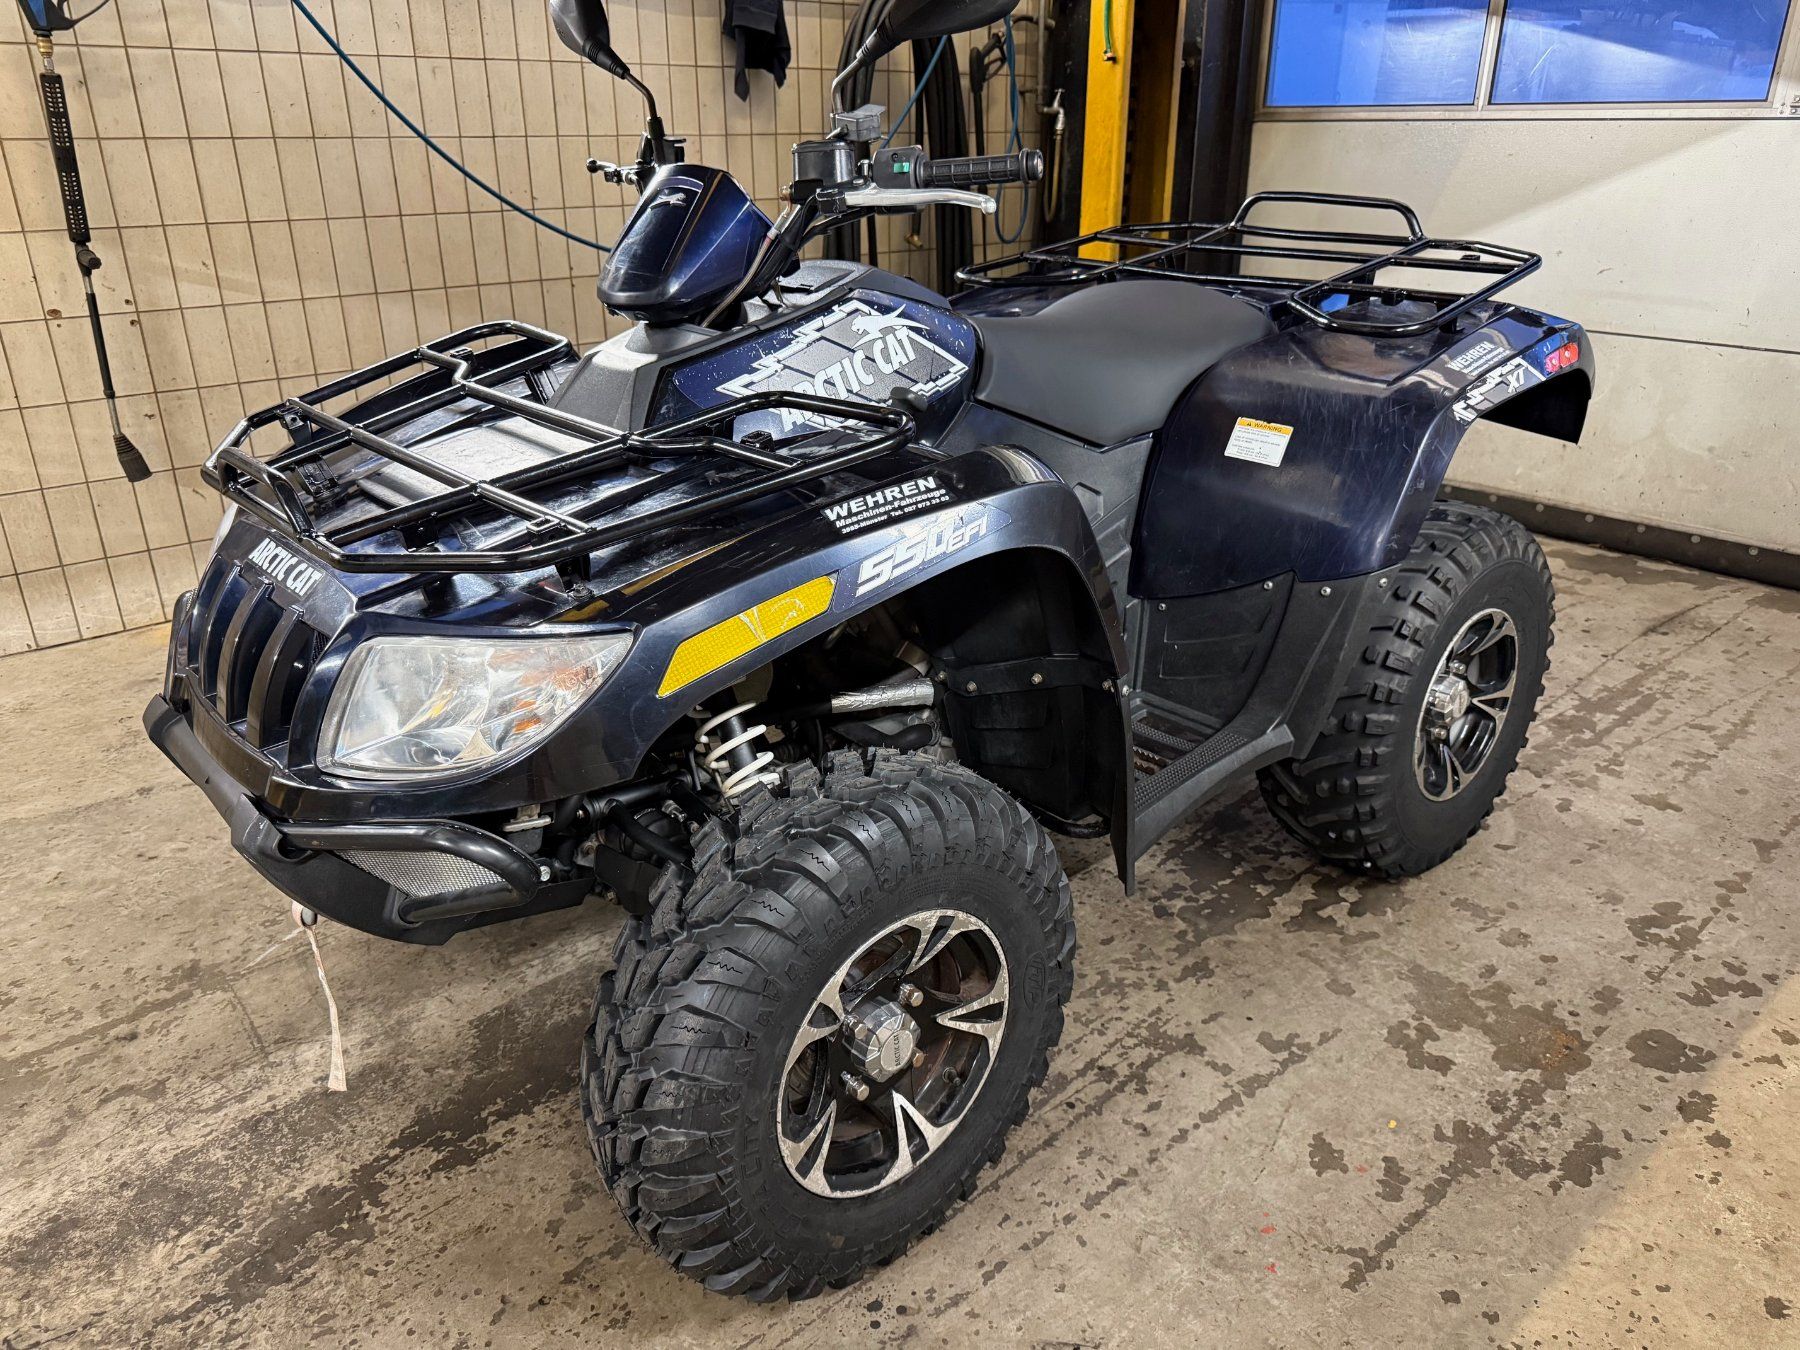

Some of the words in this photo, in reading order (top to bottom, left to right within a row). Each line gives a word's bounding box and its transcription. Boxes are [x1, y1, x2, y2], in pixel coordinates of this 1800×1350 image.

[872, 326, 916, 375] CAT
[1445, 341, 1497, 371] WEHREN
[1254, 422, 1282, 433] WARNING
[824, 476, 937, 522] WEHREN
[835, 488, 947, 529] Maschinen-Fahrzeuge
[248, 537, 299, 581] ARCTIC
[285, 562, 324, 597] CAT
